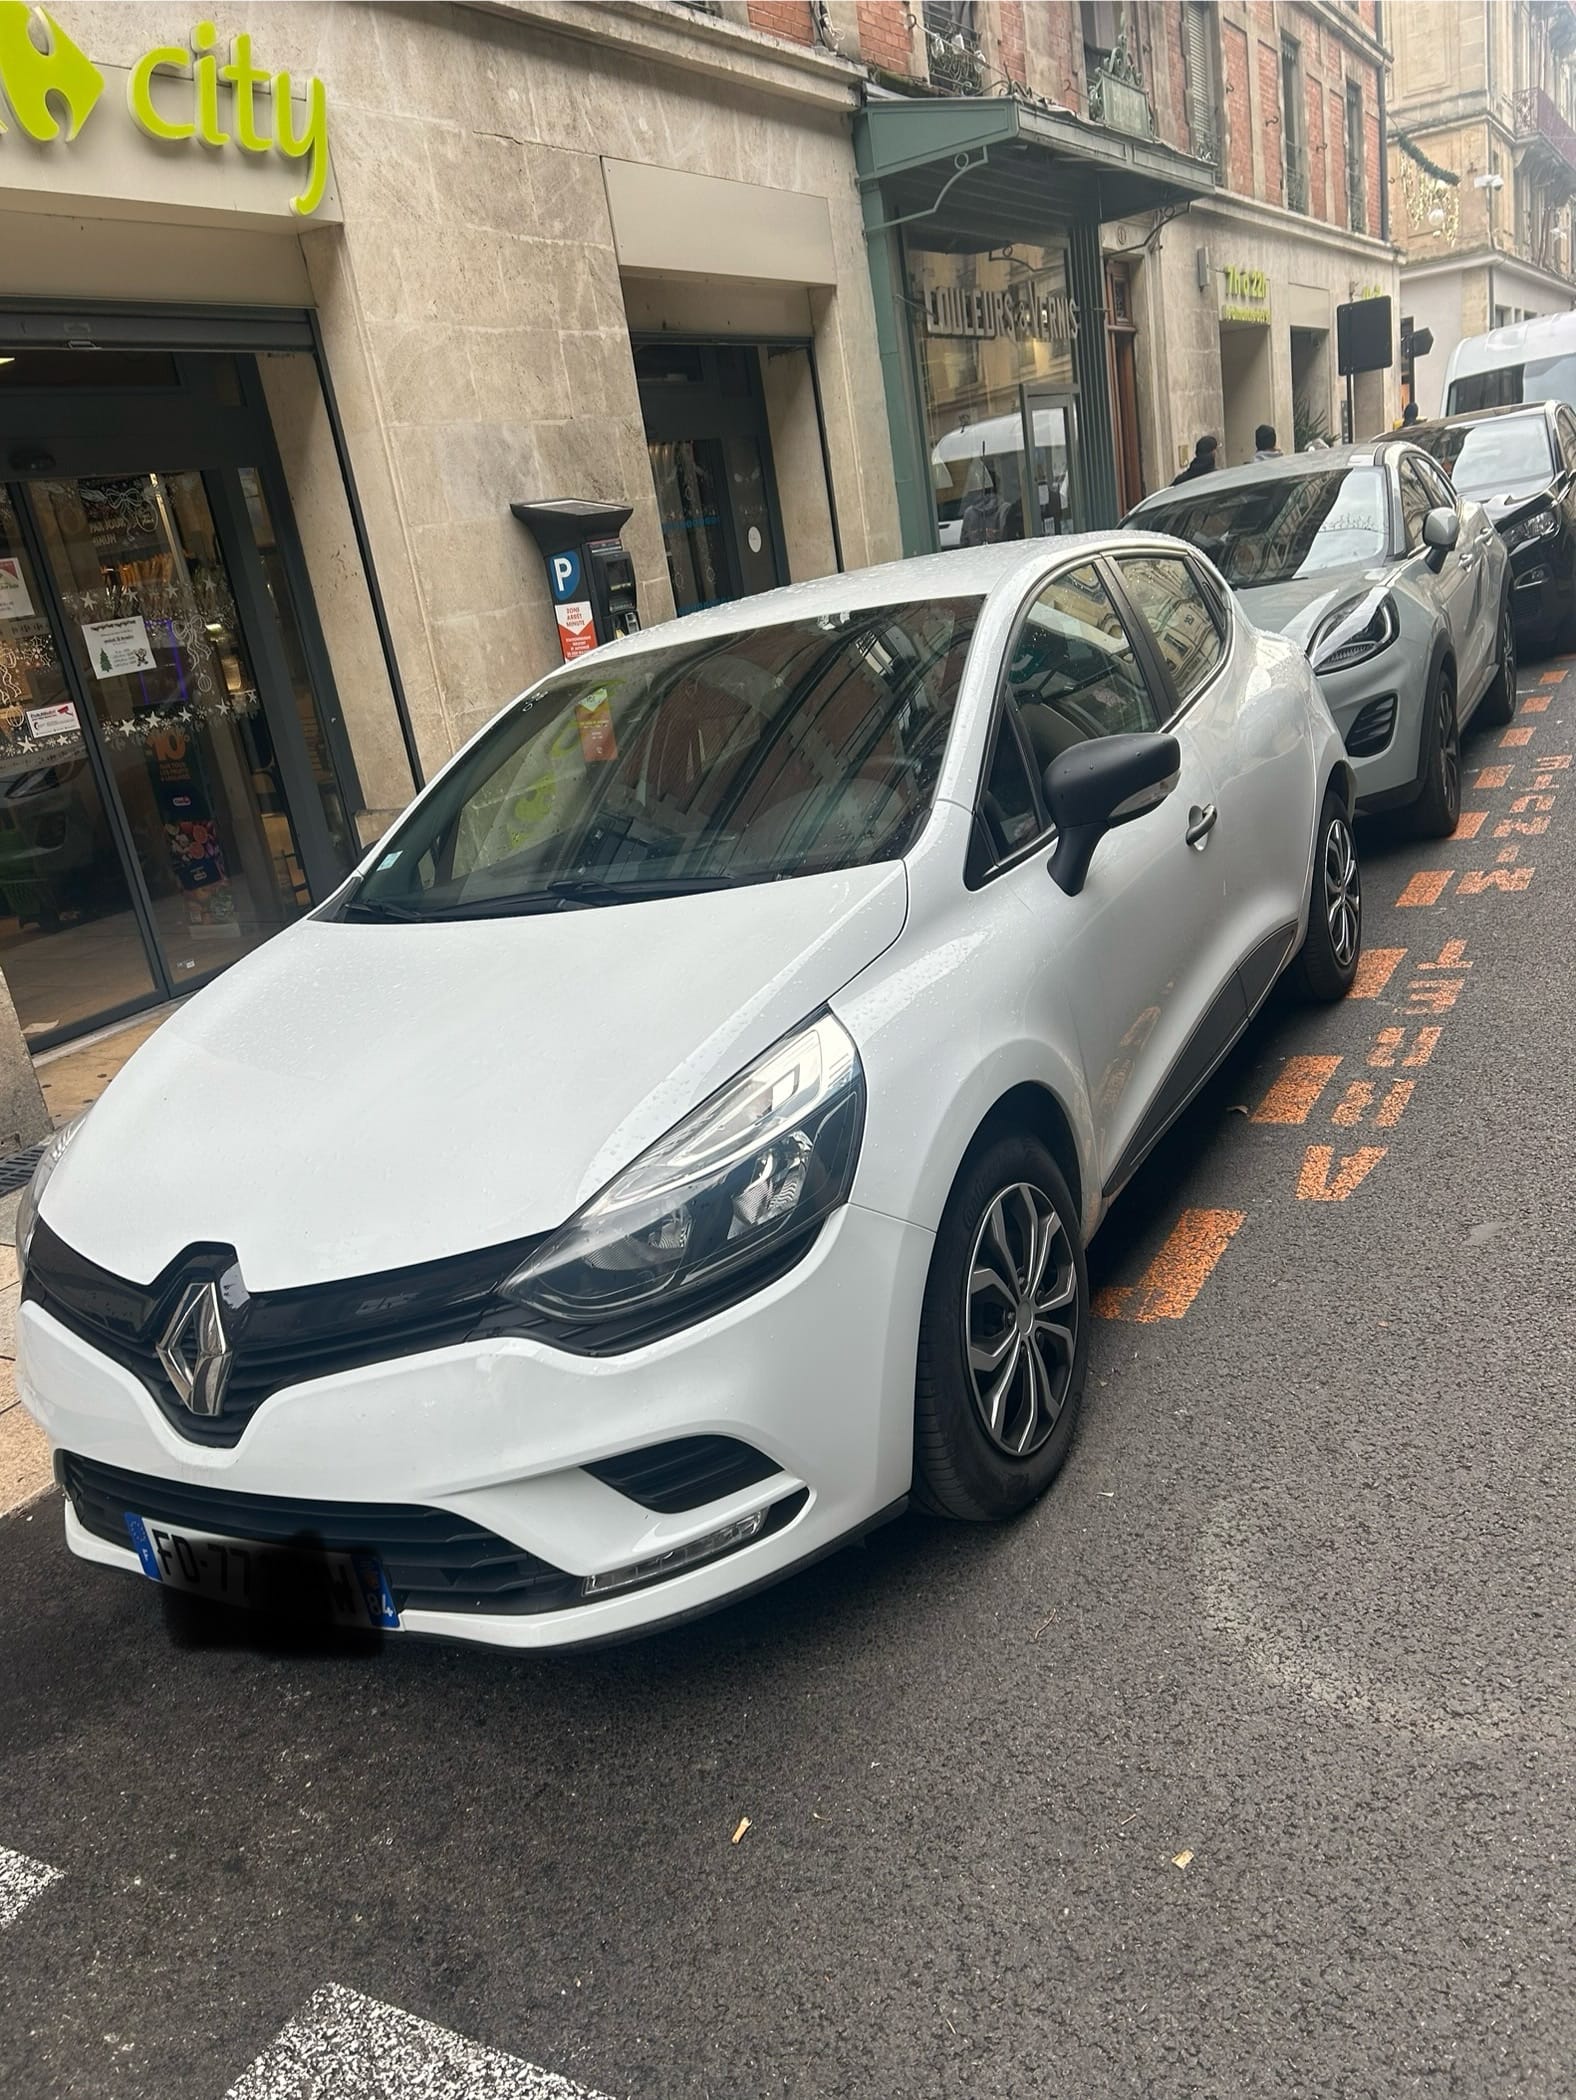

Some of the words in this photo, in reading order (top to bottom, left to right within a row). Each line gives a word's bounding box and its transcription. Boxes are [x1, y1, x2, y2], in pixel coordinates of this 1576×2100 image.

[128, 20, 329, 215] city
[1028, 280, 1079, 342] VERNIS
[553, 557, 573, 592] P
